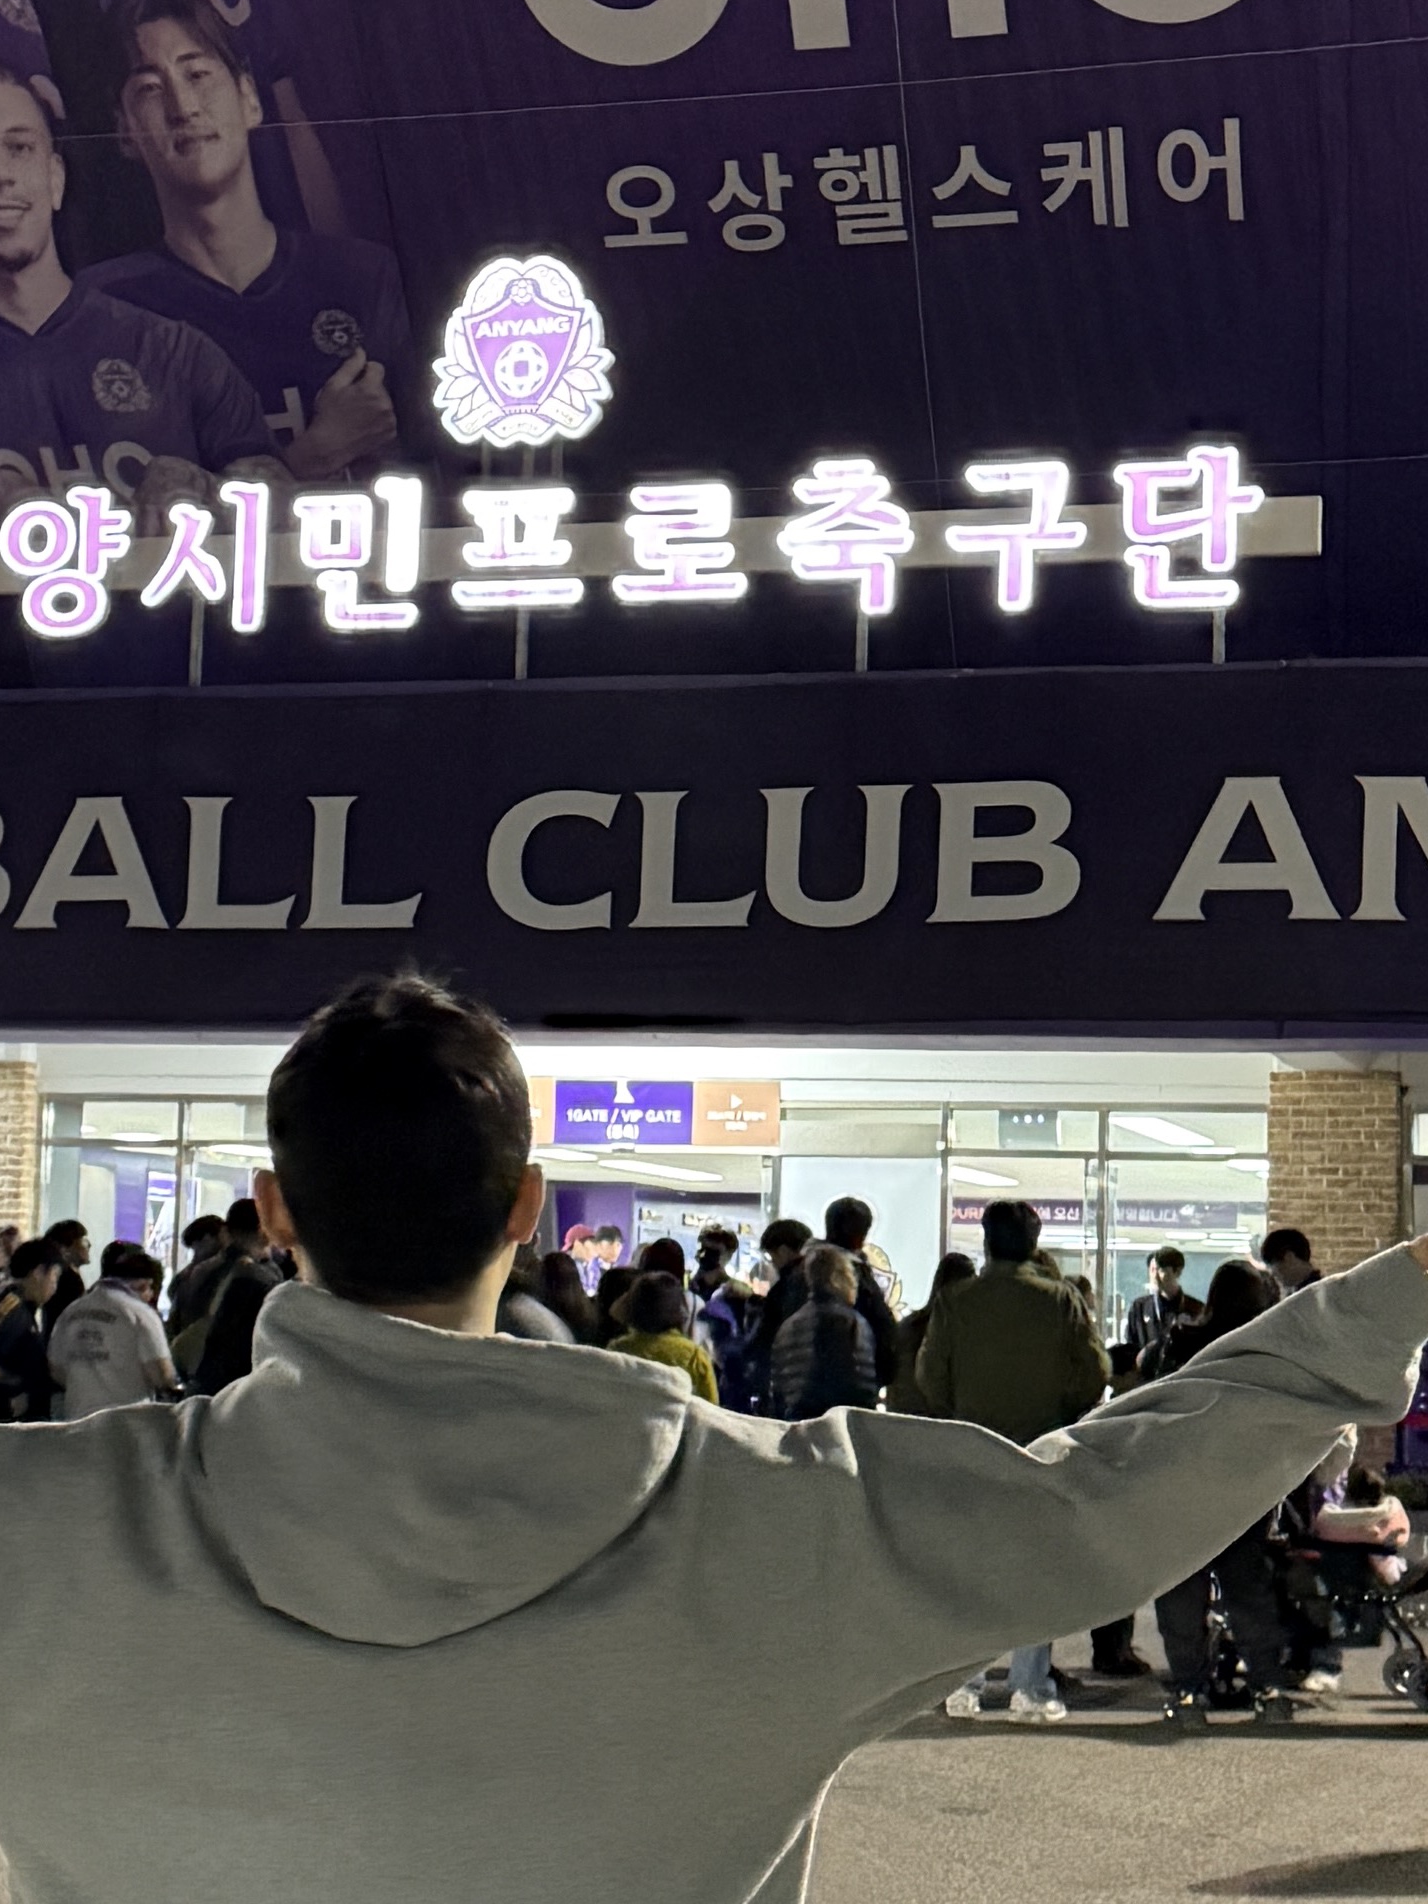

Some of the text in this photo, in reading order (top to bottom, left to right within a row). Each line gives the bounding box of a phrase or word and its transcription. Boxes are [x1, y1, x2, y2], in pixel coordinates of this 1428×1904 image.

[604, 117, 1246, 253] 오상헬스케어
[475, 315, 570, 339] ANYANG
[485, 778, 1082, 931] CLUB
[566, 1109, 609, 1123] 1GATE
[620, 1109, 643, 1123] VIP
[645, 1109, 682, 1124] GATE
